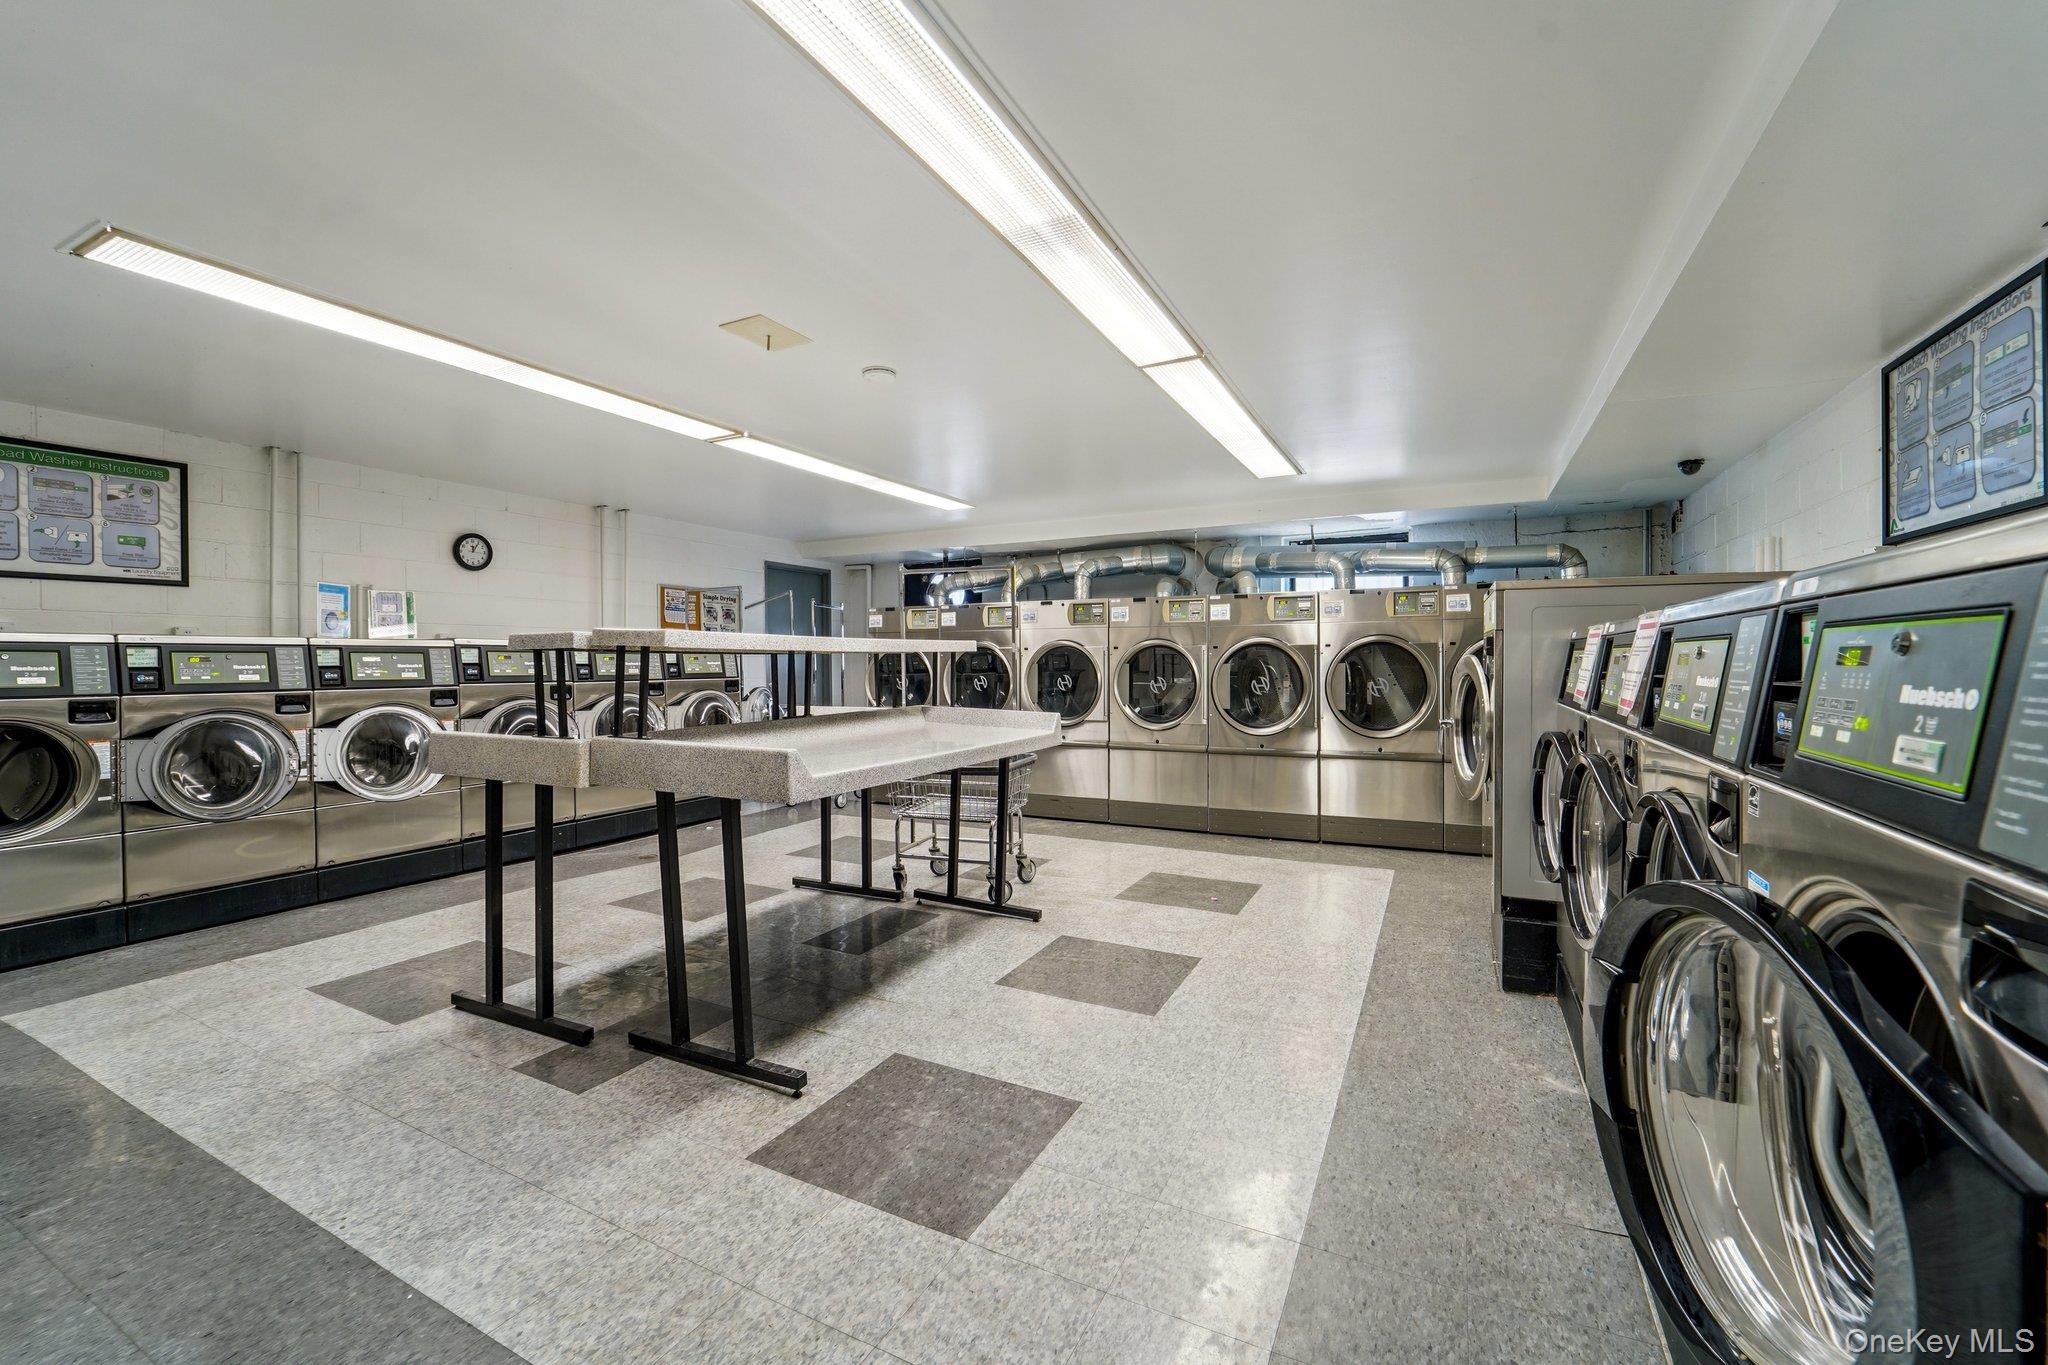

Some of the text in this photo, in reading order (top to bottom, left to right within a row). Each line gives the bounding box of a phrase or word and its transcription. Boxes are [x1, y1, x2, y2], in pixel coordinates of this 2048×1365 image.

[1930, 328, 1968, 359] Washing
[1970, 285, 2033, 335] Instructions
[29, 451, 83, 468] Washer
[89, 460, 164, 478] Instructions
[1899, 684, 1965, 709] Huebsch
[1913, 715, 1924, 733] 2
